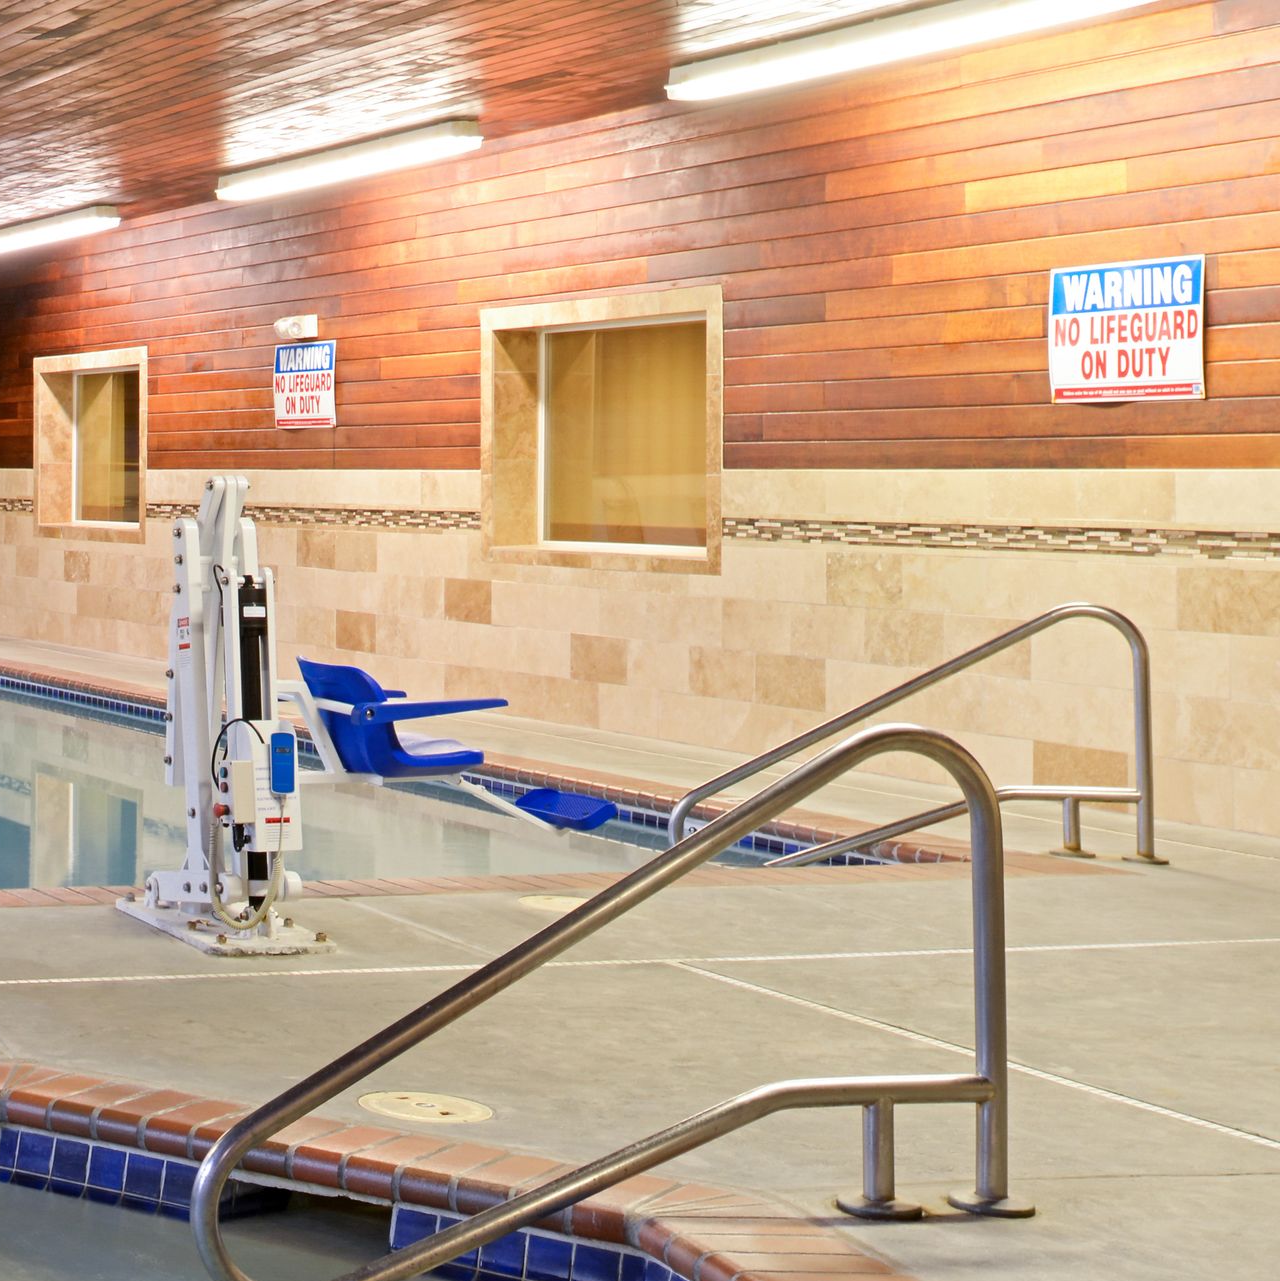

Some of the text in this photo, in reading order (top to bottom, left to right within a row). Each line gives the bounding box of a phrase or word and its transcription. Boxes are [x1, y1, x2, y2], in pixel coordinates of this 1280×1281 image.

[1062, 264, 1192, 312] WARNING
[1055, 309, 1198, 347] NO LIFEGUARD
[280, 345, 330, 372] WARNING
[1081, 347, 1171, 379] ON DUTY
[275, 372, 331, 393] NO LIFEGUARD
[285, 395, 320, 414] ON DUTY
